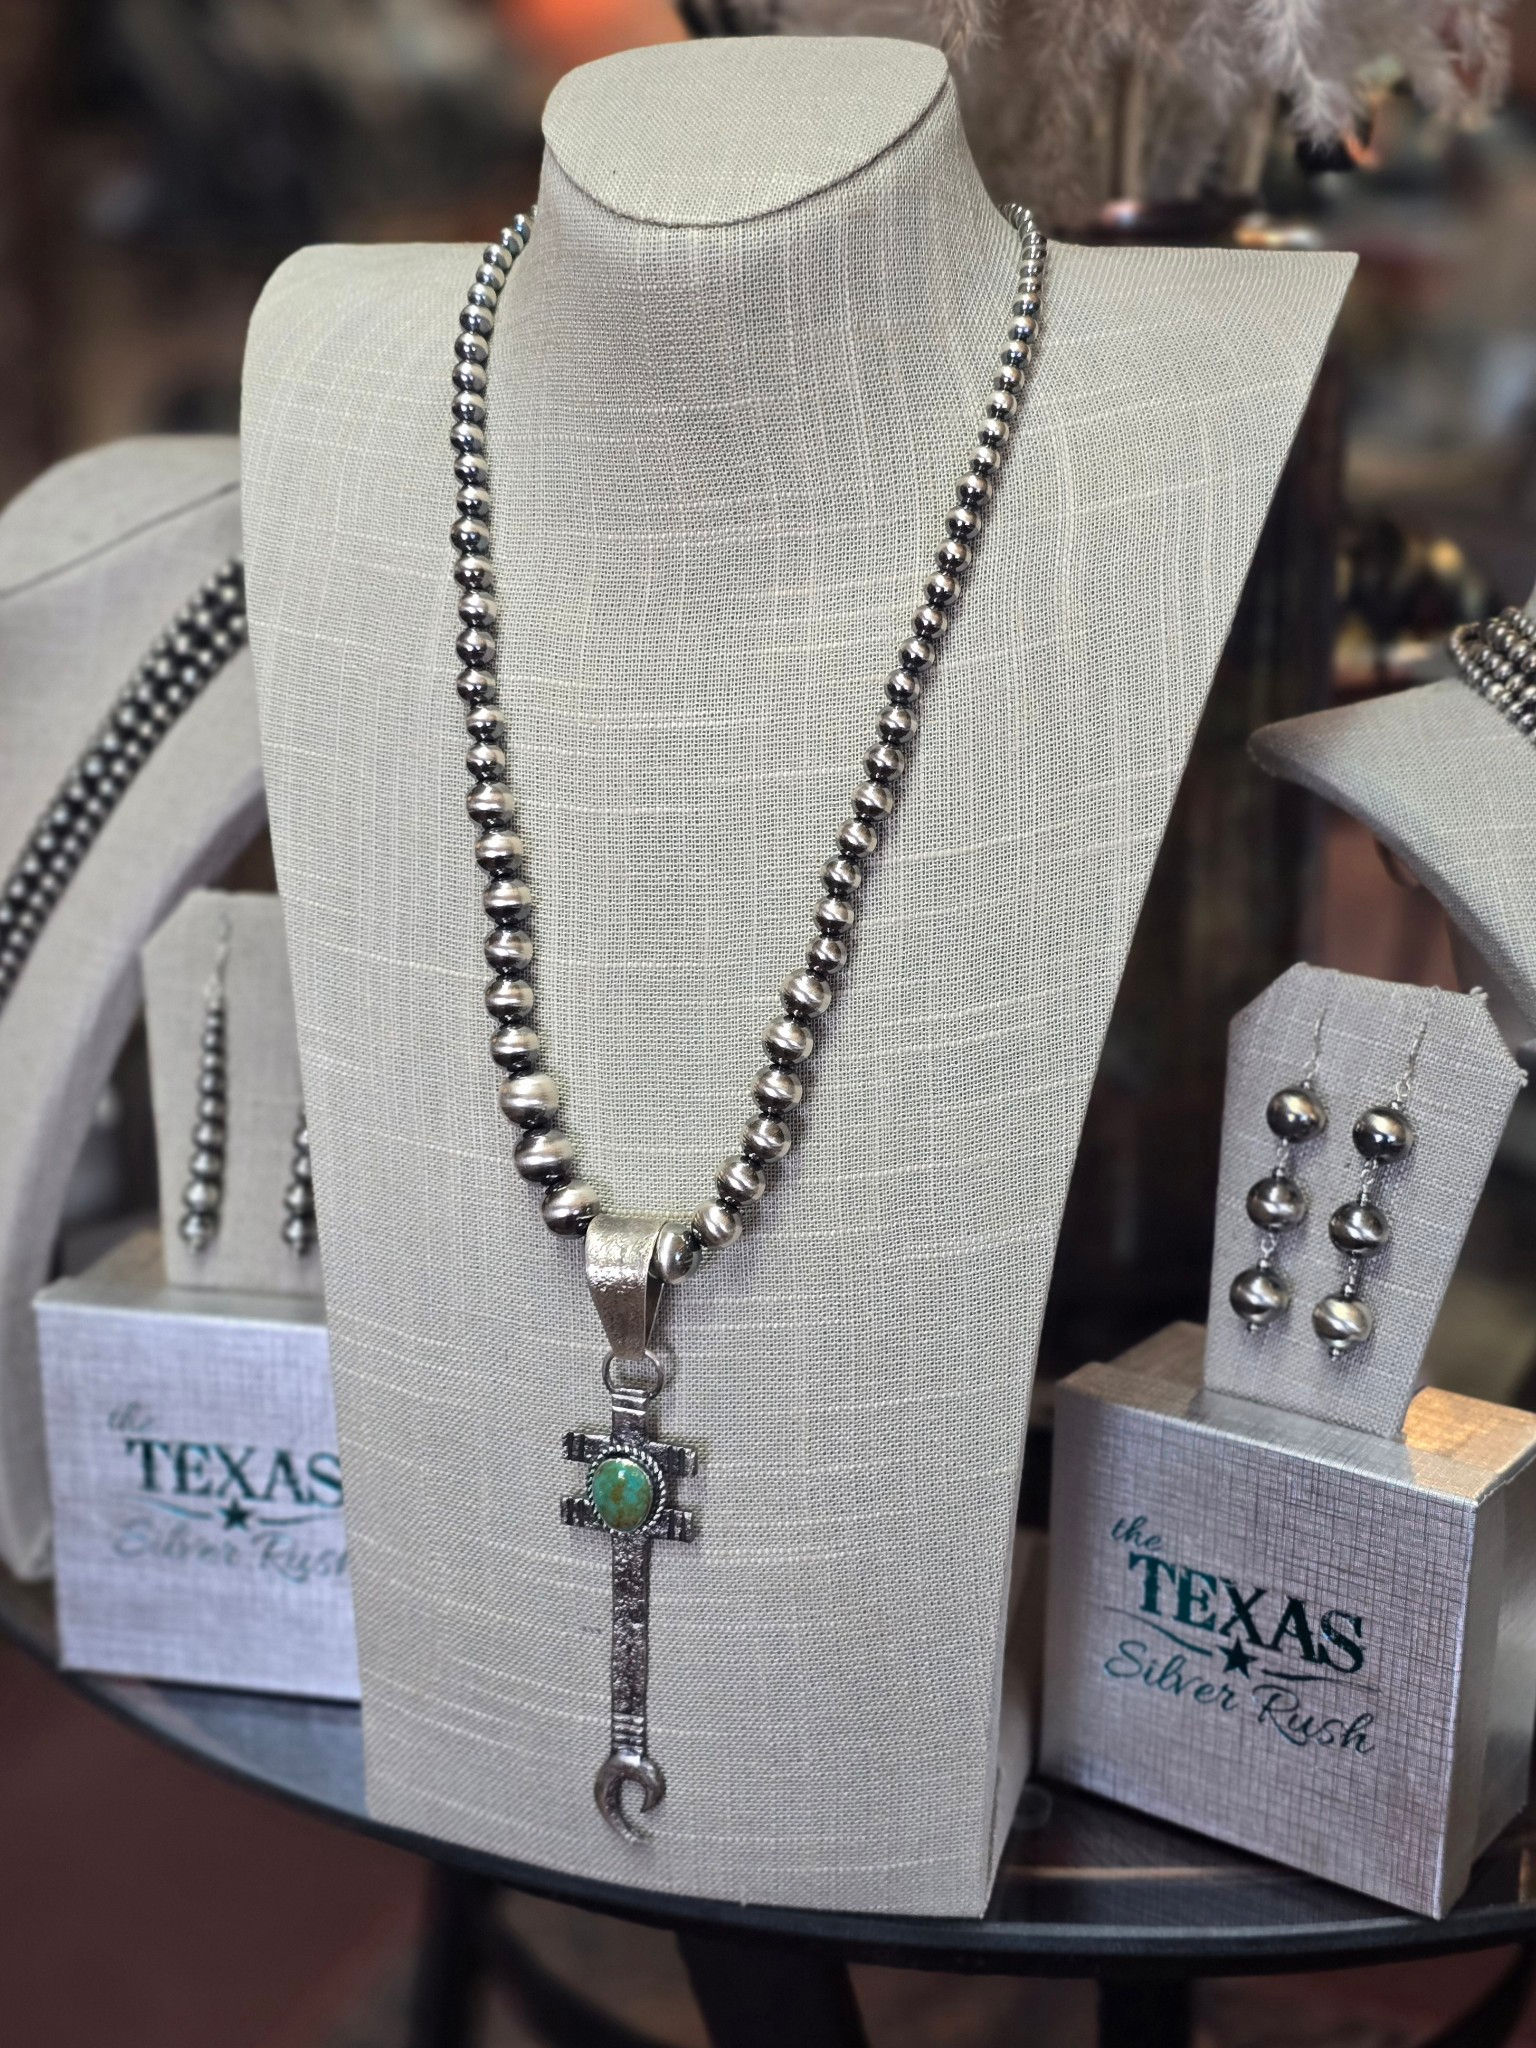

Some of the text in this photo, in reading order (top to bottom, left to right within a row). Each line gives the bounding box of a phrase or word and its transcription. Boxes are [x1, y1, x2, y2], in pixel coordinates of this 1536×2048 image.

[124, 1438, 343, 1508] TEXAS
[1111, 1515, 1161, 1550] the
[1128, 1552, 1364, 1674] TEXAS
[1103, 1640, 1376, 1754] Silver Rush
